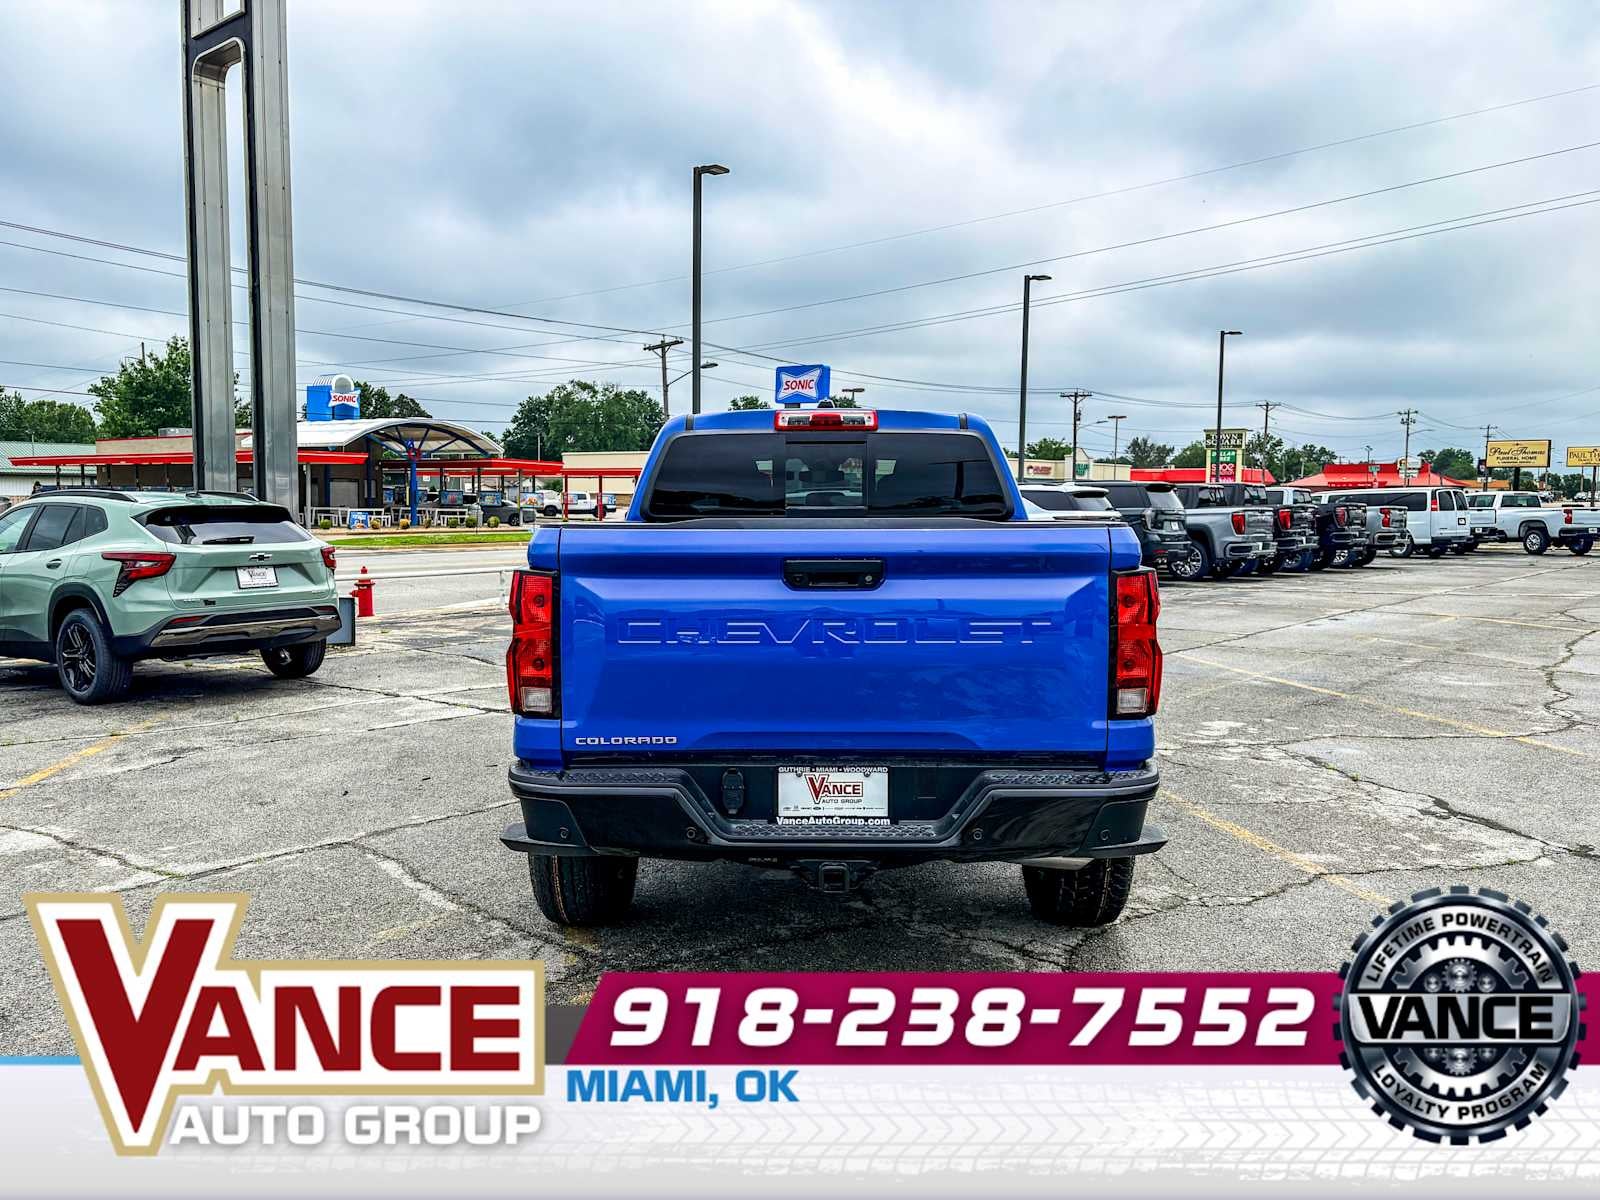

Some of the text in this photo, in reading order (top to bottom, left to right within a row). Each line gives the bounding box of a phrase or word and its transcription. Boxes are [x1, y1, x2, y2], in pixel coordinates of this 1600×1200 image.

[784, 379, 815, 391] SONIC
[332, 394, 357, 403] SONIC
[1569, 451, 1588, 459] PAUL
[617, 617, 1053, 644] CHEVROLET
[575, 735, 678, 746] COLORADO
[807, 776, 861, 801] VANCE
[776, 816, 891, 826] VanceAutoGroup.com
